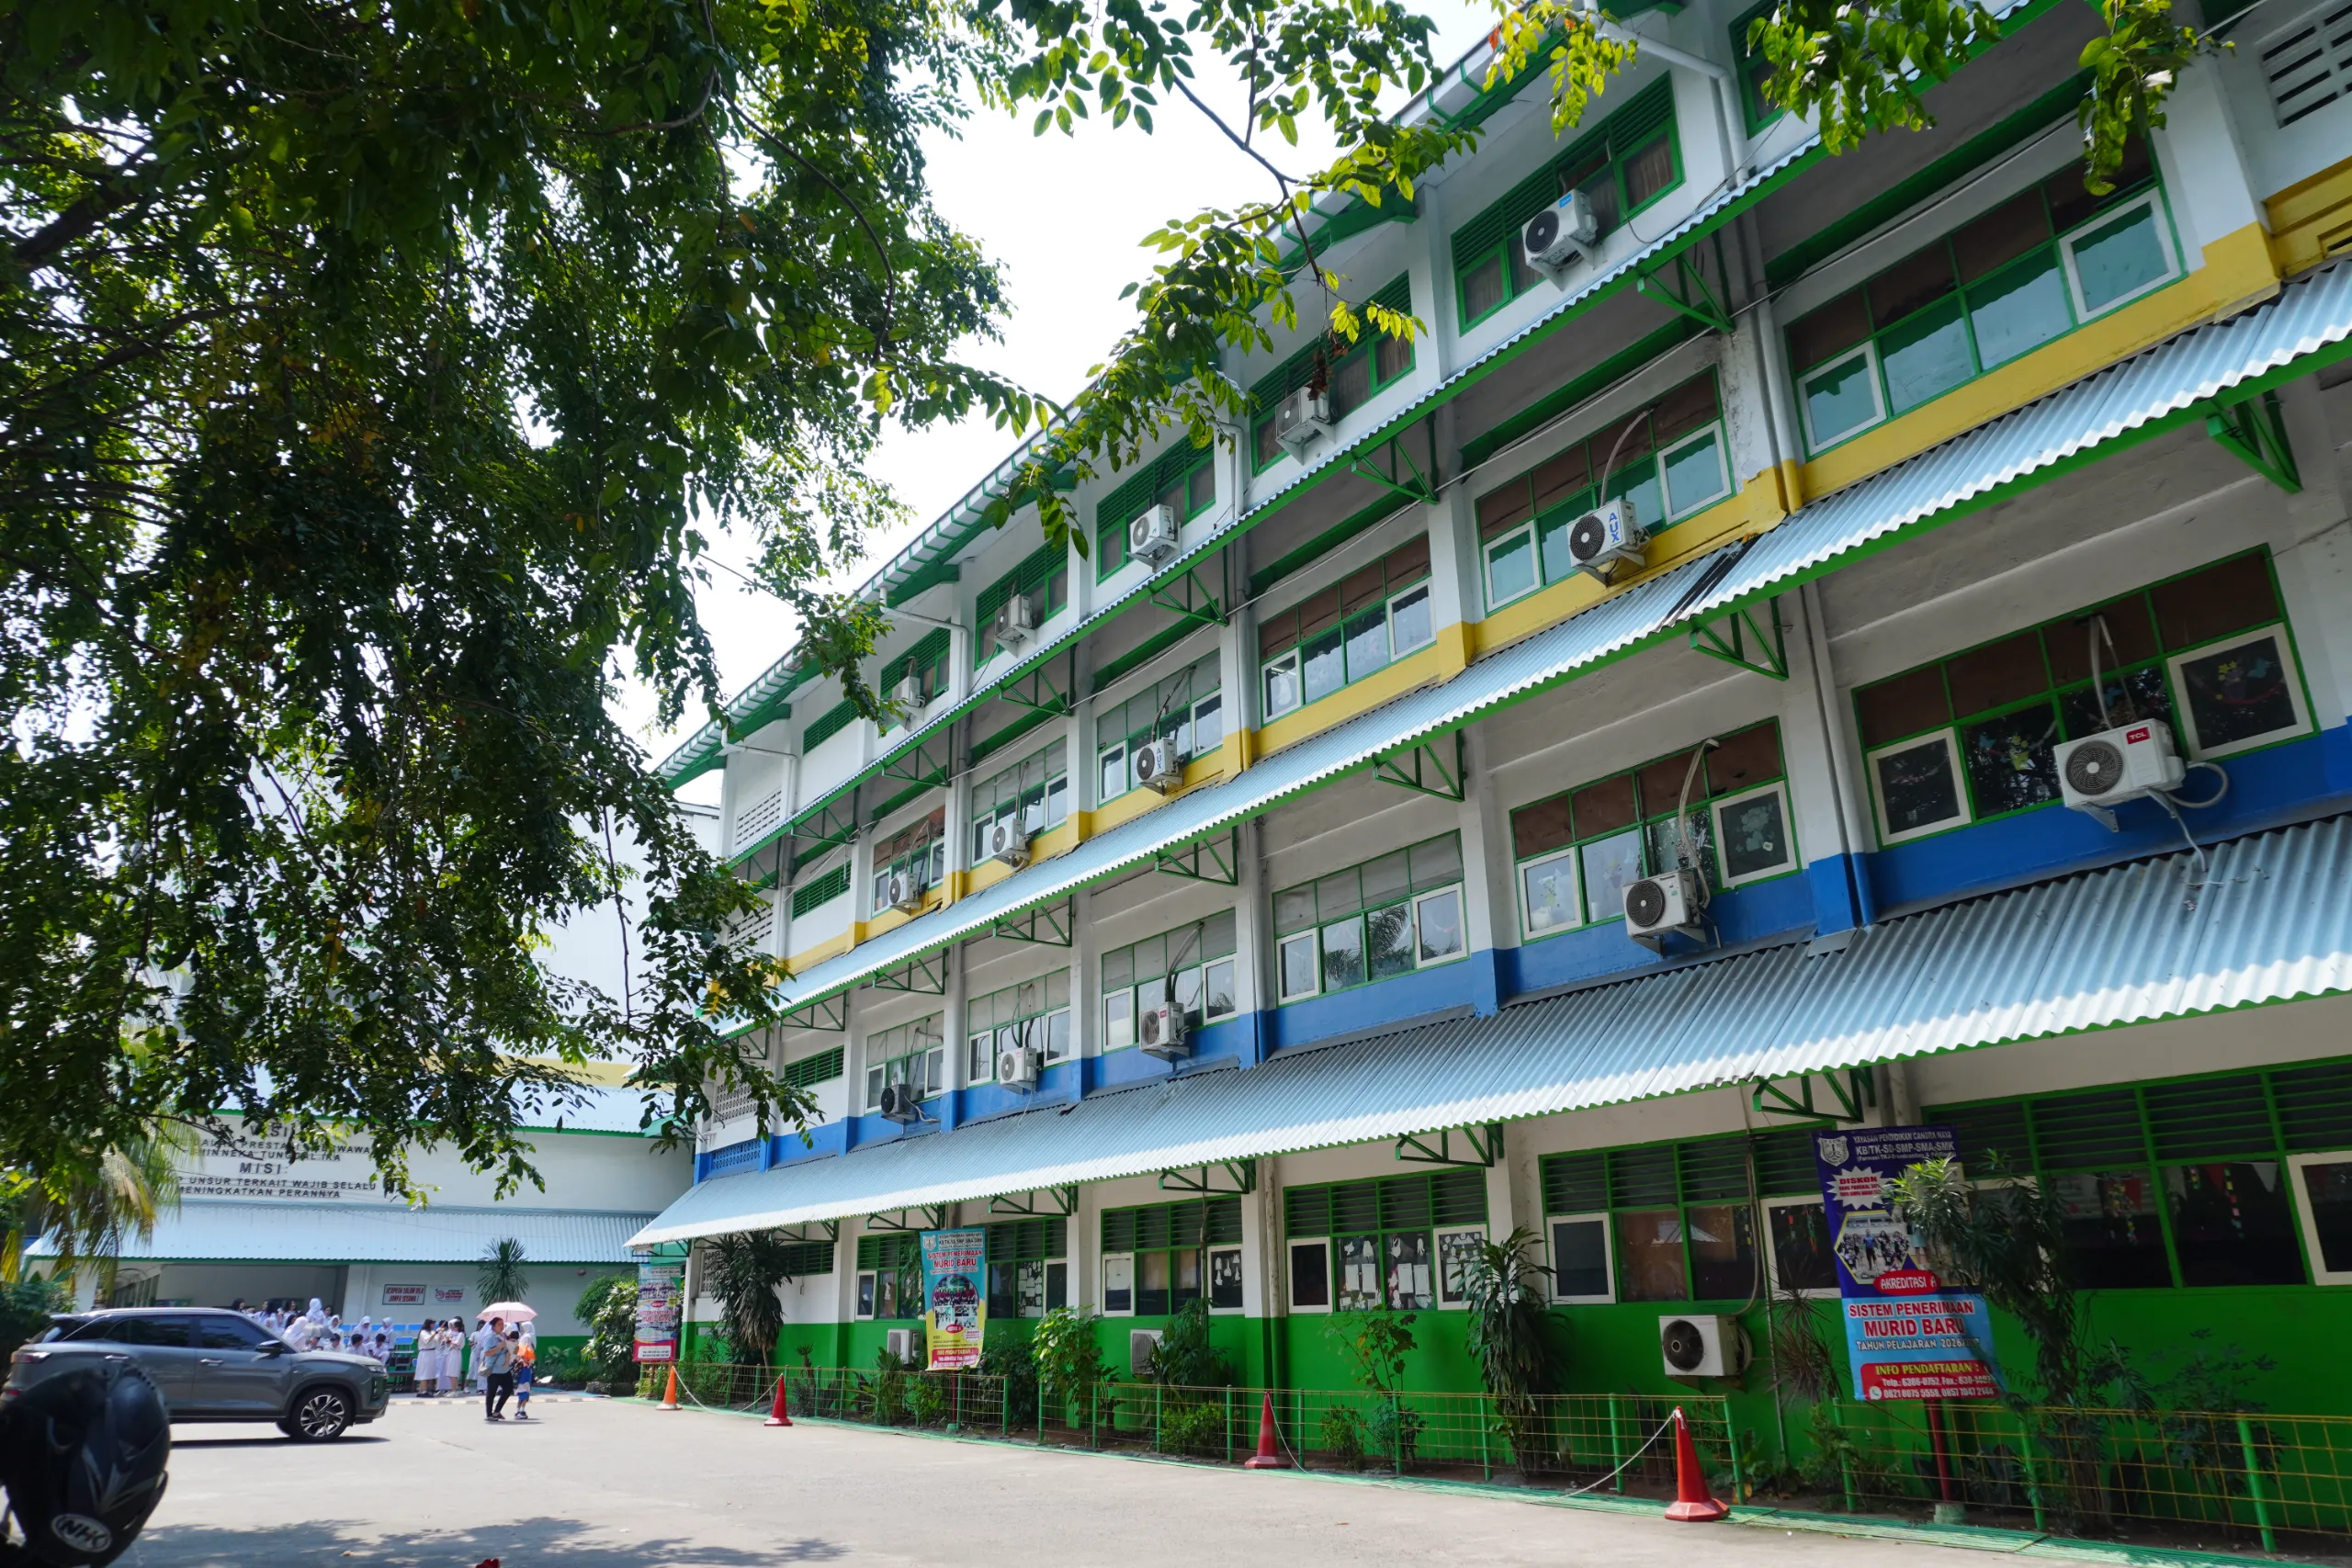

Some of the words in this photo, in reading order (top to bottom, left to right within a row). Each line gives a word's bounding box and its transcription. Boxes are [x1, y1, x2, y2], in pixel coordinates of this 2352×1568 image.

[1610, 512, 1620, 543] AUX
[250, 1124, 289, 1137] VSI
[1852, 1135, 1879, 1144] YAYASAN
[1879, 1132, 1913, 1142] PENDIDIKAN
[242, 1141, 300, 1150] PRESTAI
[189, 1177, 231, 1185] UNSUR
[236, 1178, 288, 1187] TERKAIT
[291, 1180, 329, 1189] WAJIB
[333, 1181, 377, 1190] SELALU
[1839, 1176, 1878, 1184] DISKON
[278, 1188, 341, 1198] PERANNYA
[956, 1258, 977, 1267] BARU
[1881, 1276, 1928, 1290] AKREDITASI
[1930, 1276, 1937, 1287] A
[1849, 1303, 1893, 1317] SISTEM
[1896, 1302, 1974, 1315] PENERIMAAN
[1864, 1319, 1917, 1337] MURID
[1922, 1317, 1965, 1335] BARU
[1856, 1340, 1884, 1351] TAHUN
[1887, 1338, 1937, 1350] PELAJARAN
[1875, 1365, 1899, 1375] INFO
[1903, 1362, 1973, 1374] PENDAFTARAN
[58, 1519, 108, 1547] NHK
